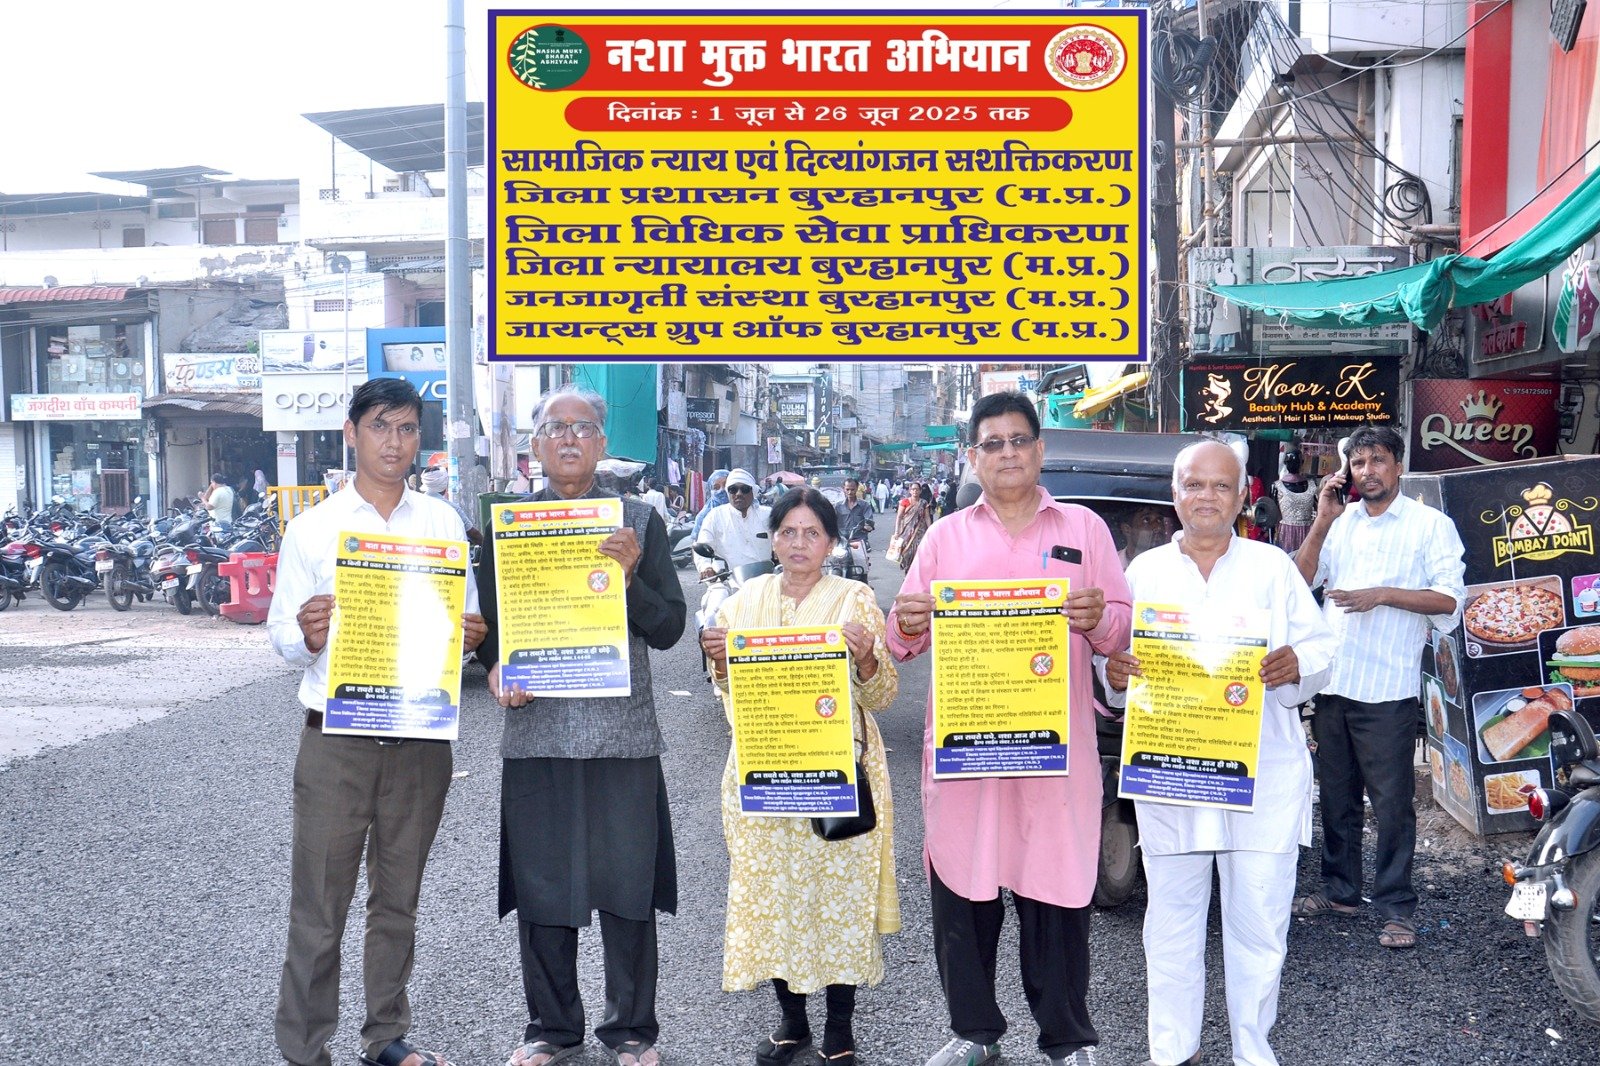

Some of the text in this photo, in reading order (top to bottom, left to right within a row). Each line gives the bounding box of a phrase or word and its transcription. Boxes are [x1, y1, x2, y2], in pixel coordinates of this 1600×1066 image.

[28, 395, 137, 413] जगदीश वॉच कम्पनी
[1249, 402, 1382, 413] Beauty Hub & Academy
[1242, 415, 1276, 423] Aesthetic
[1333, 414, 1364, 422] Makeup
[1420, 413, 1538, 465] Queen
[1497, 537, 1548, 558] BOMBAY
